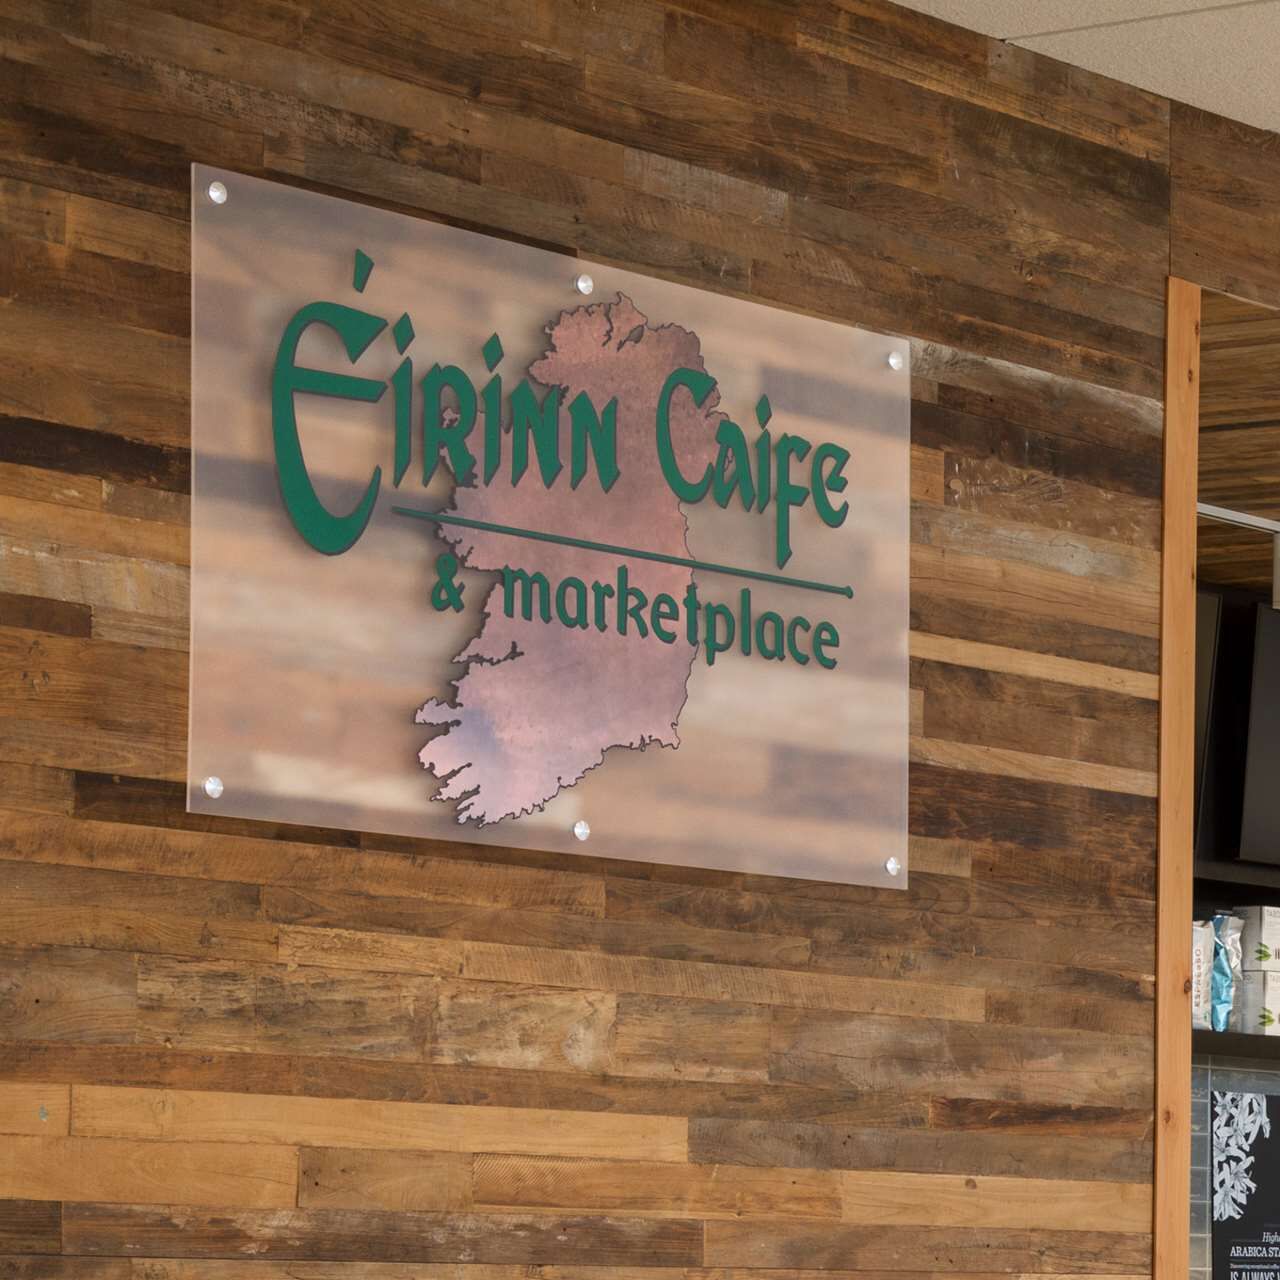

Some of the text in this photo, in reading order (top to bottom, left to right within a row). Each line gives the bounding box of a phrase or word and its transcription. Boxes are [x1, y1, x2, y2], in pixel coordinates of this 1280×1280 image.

[656, 367, 851, 569] Caife
[430, 552, 840, 669] & marketplace
[1230, 1246, 1267, 1258] ARABICA
